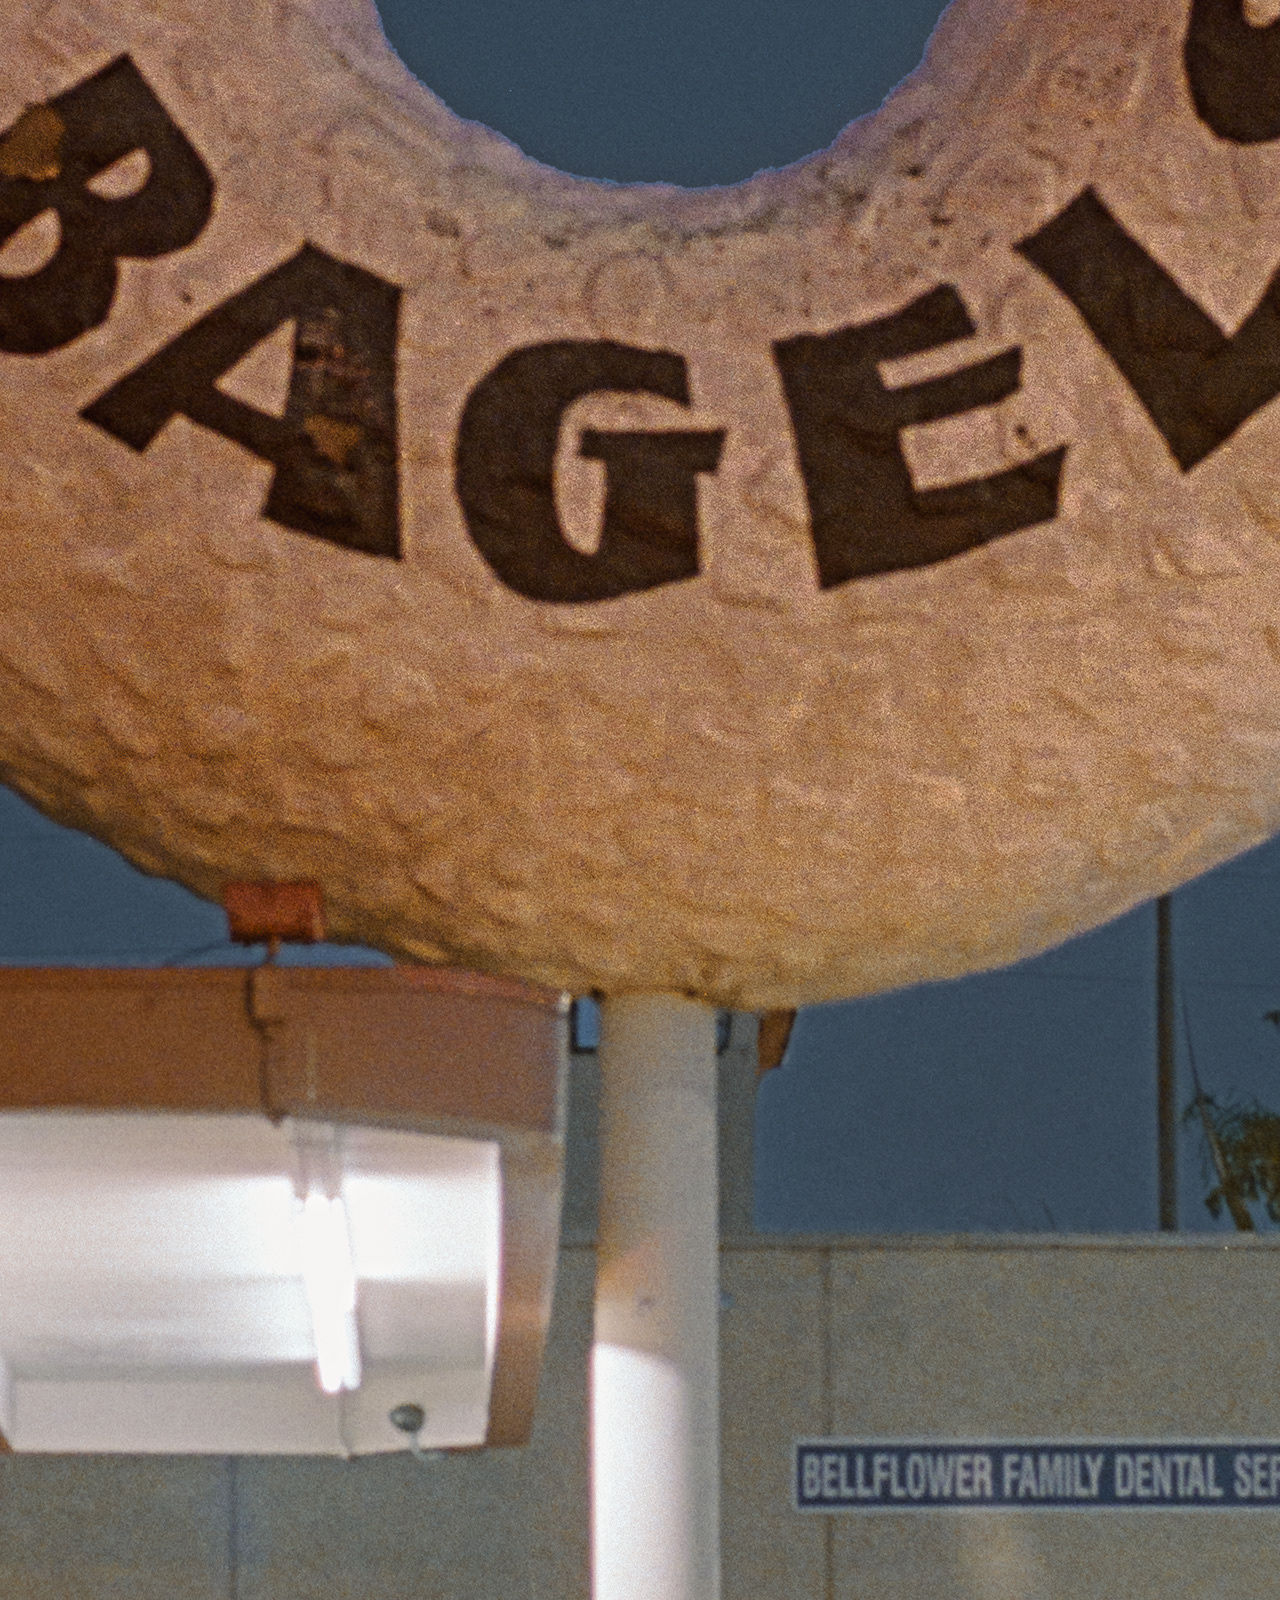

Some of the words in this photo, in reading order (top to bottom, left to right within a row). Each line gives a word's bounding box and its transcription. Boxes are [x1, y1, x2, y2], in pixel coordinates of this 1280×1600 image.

[802, 1453, 994, 1498] BELLFLOWER
[1002, 1454, 1105, 1497] FAMILY
[1115, 1454, 1222, 1498] DENTAL
